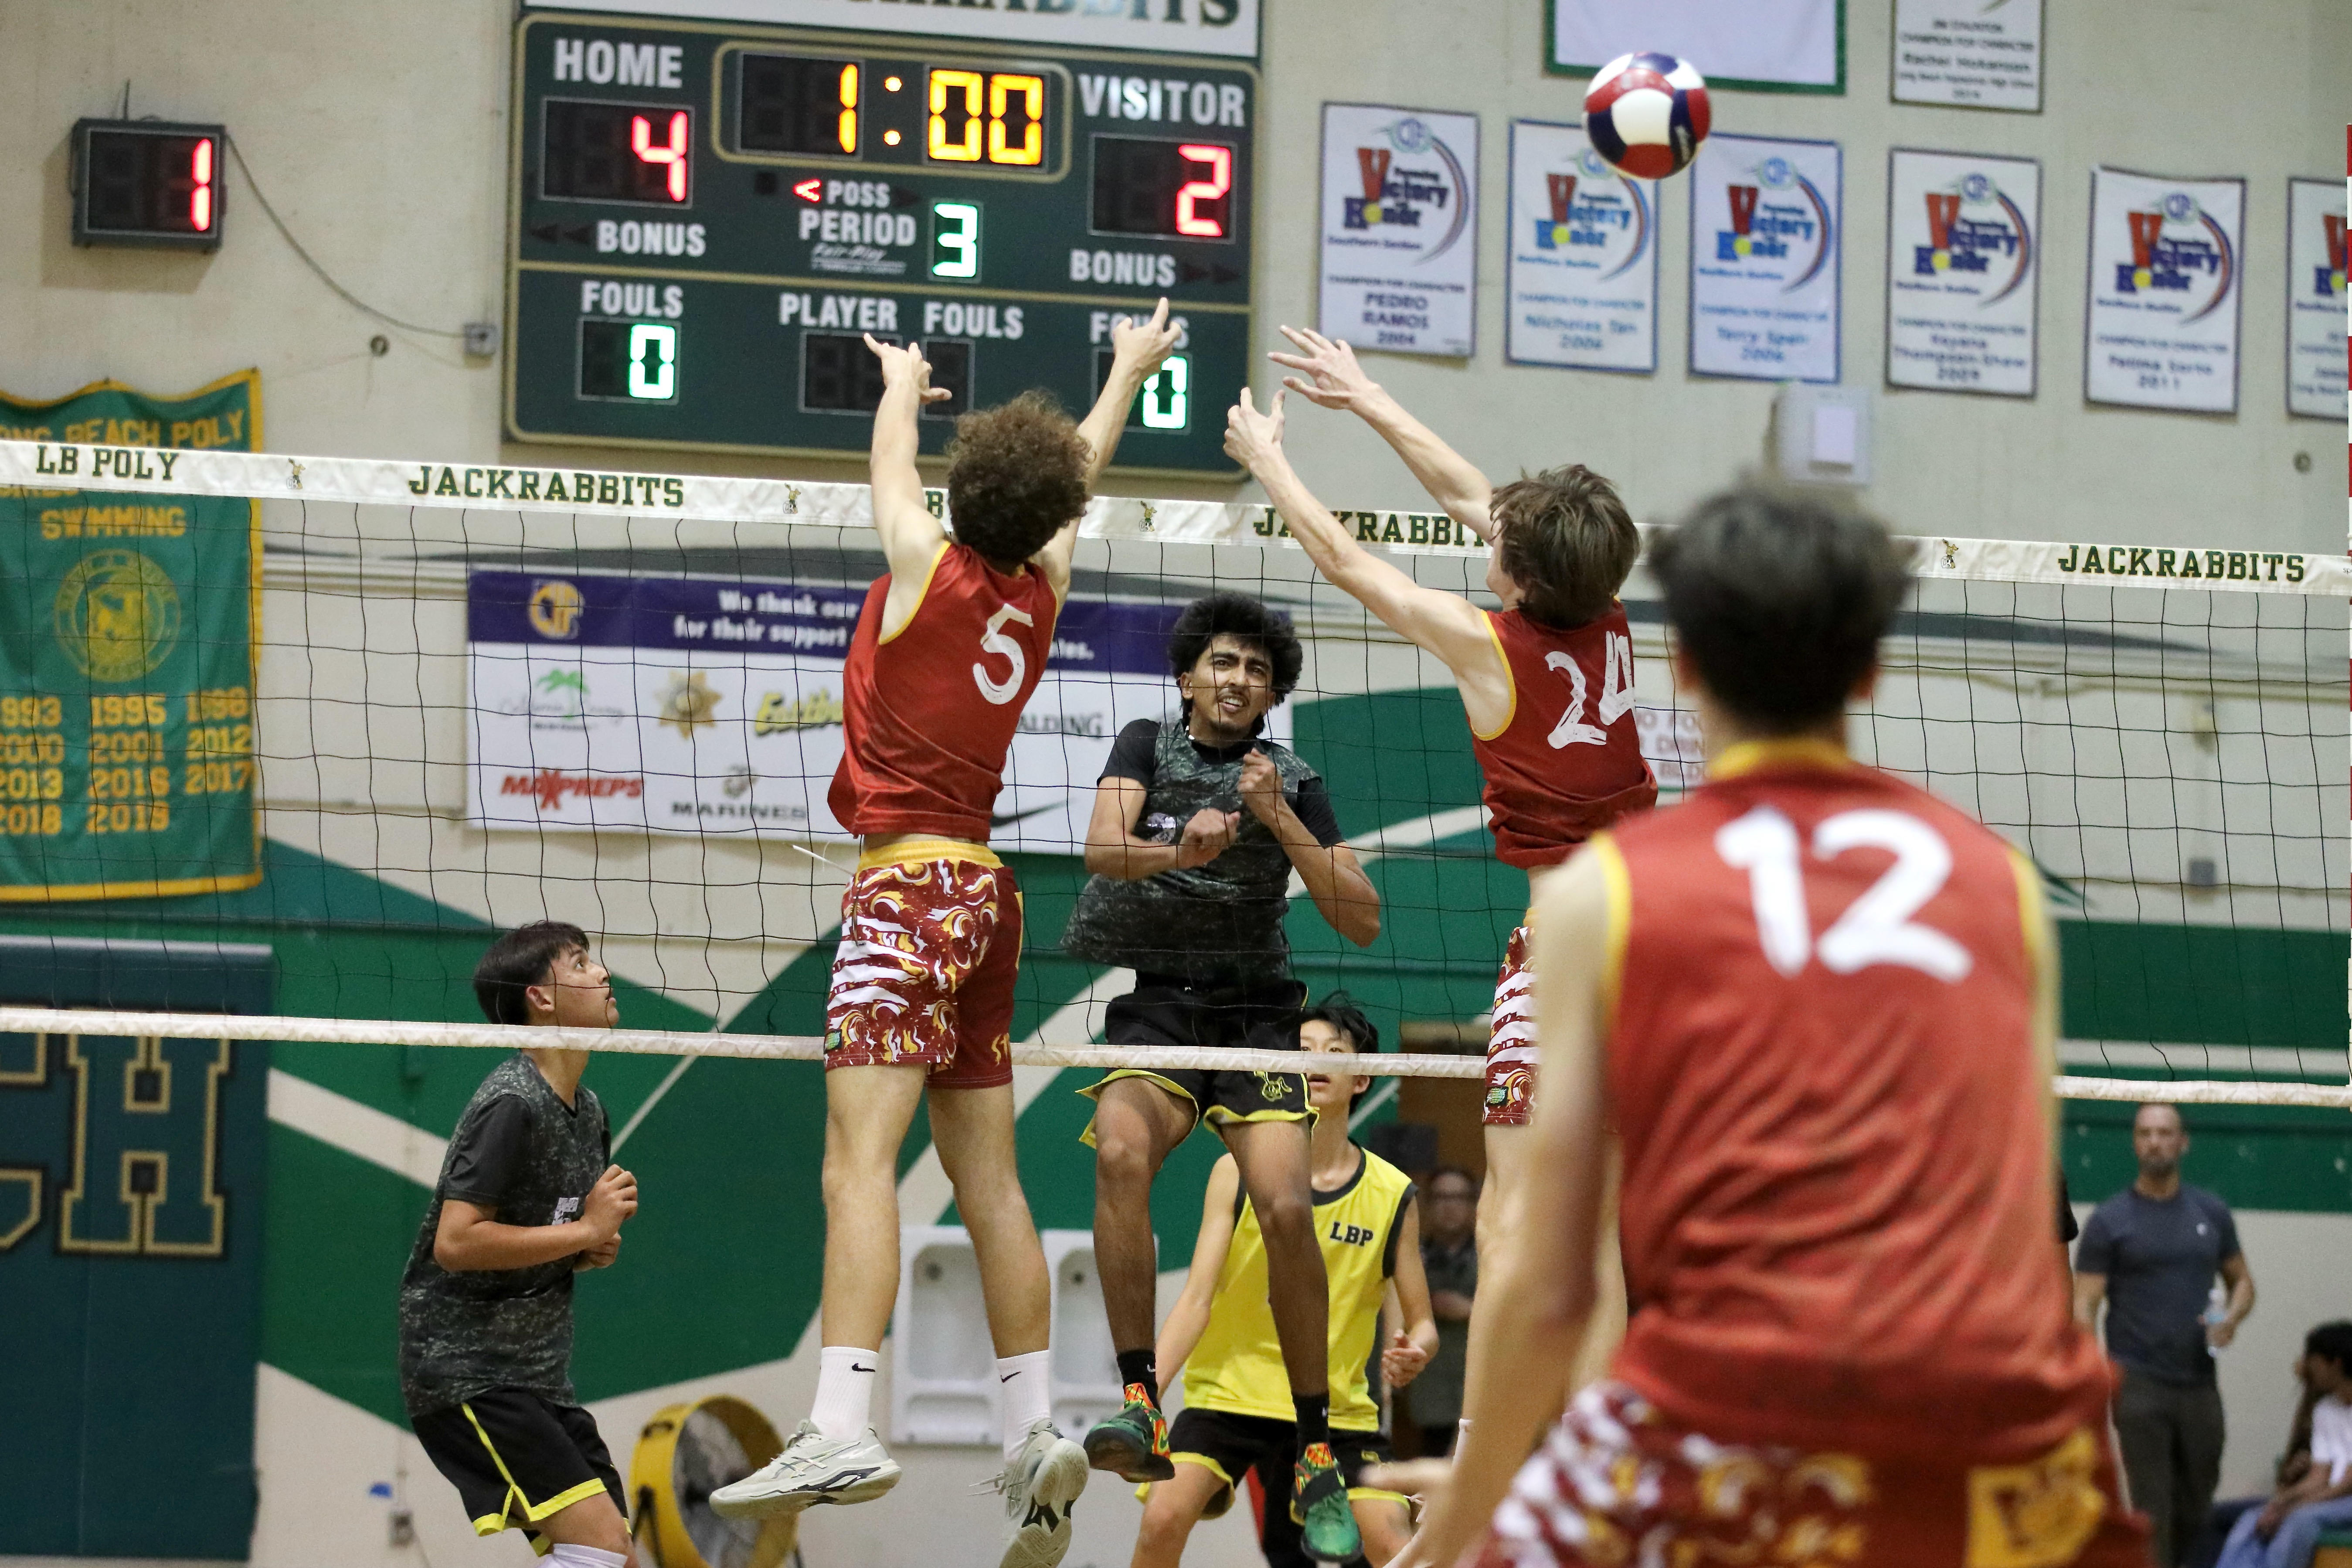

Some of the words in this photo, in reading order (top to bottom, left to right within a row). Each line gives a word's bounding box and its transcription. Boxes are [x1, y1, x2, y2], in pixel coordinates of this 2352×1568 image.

[554, 38, 683, 88] HOME
[1077, 73, 1246, 127] VISITOR
[632, 111, 688, 202] 4
[190, 139, 212, 231] 1
[828, 180, 890, 208] POSS
[1176, 144, 1231, 237] 2
[597, 221, 706, 258] BONUS
[799, 209, 917, 247] PERIOD
[932, 203, 978, 278] 3
[1069, 248, 1176, 288] BONUS
[581, 280, 683, 319] FOULS
[779, 292, 897, 331] PLAYER
[923, 301, 1024, 340] FOULS
[1365, 292, 1429, 311] PEDRO
[629, 324, 676, 399] 0
[1143, 356, 1187, 429] 0
[172, 409, 244, 449] POLY
[37, 444, 78, 474] LB
[92, 448, 179, 481] POLY
[408, 465, 684, 508] JACKRABBITS
[41, 504, 186, 540] SWIMMING
[2058, 544, 2304, 582] JACKRABBITS
[717, 589, 752, 611] We
[756, 591, 818, 616] thank
[820, 602, 860, 619] our
[673, 614, 707, 639] for
[711, 616, 765, 642] their
[769, 624, 847, 650] support
[973, 603, 1033, 705] 5
[0, 695, 62, 728] 993
[91, 692, 167, 727] 1995
[1544, 631, 1636, 750] 24
[87, 730, 165, 764] 2001
[185, 724, 252, 759] 2012
[184, 761, 252, 795] 2017
[500, 768, 645, 810] MAXPREPS
[670, 800, 808, 820] MARINES
[1713, 803, 1974, 984] 12
[1329, 1221, 1374, 1247] LBP
